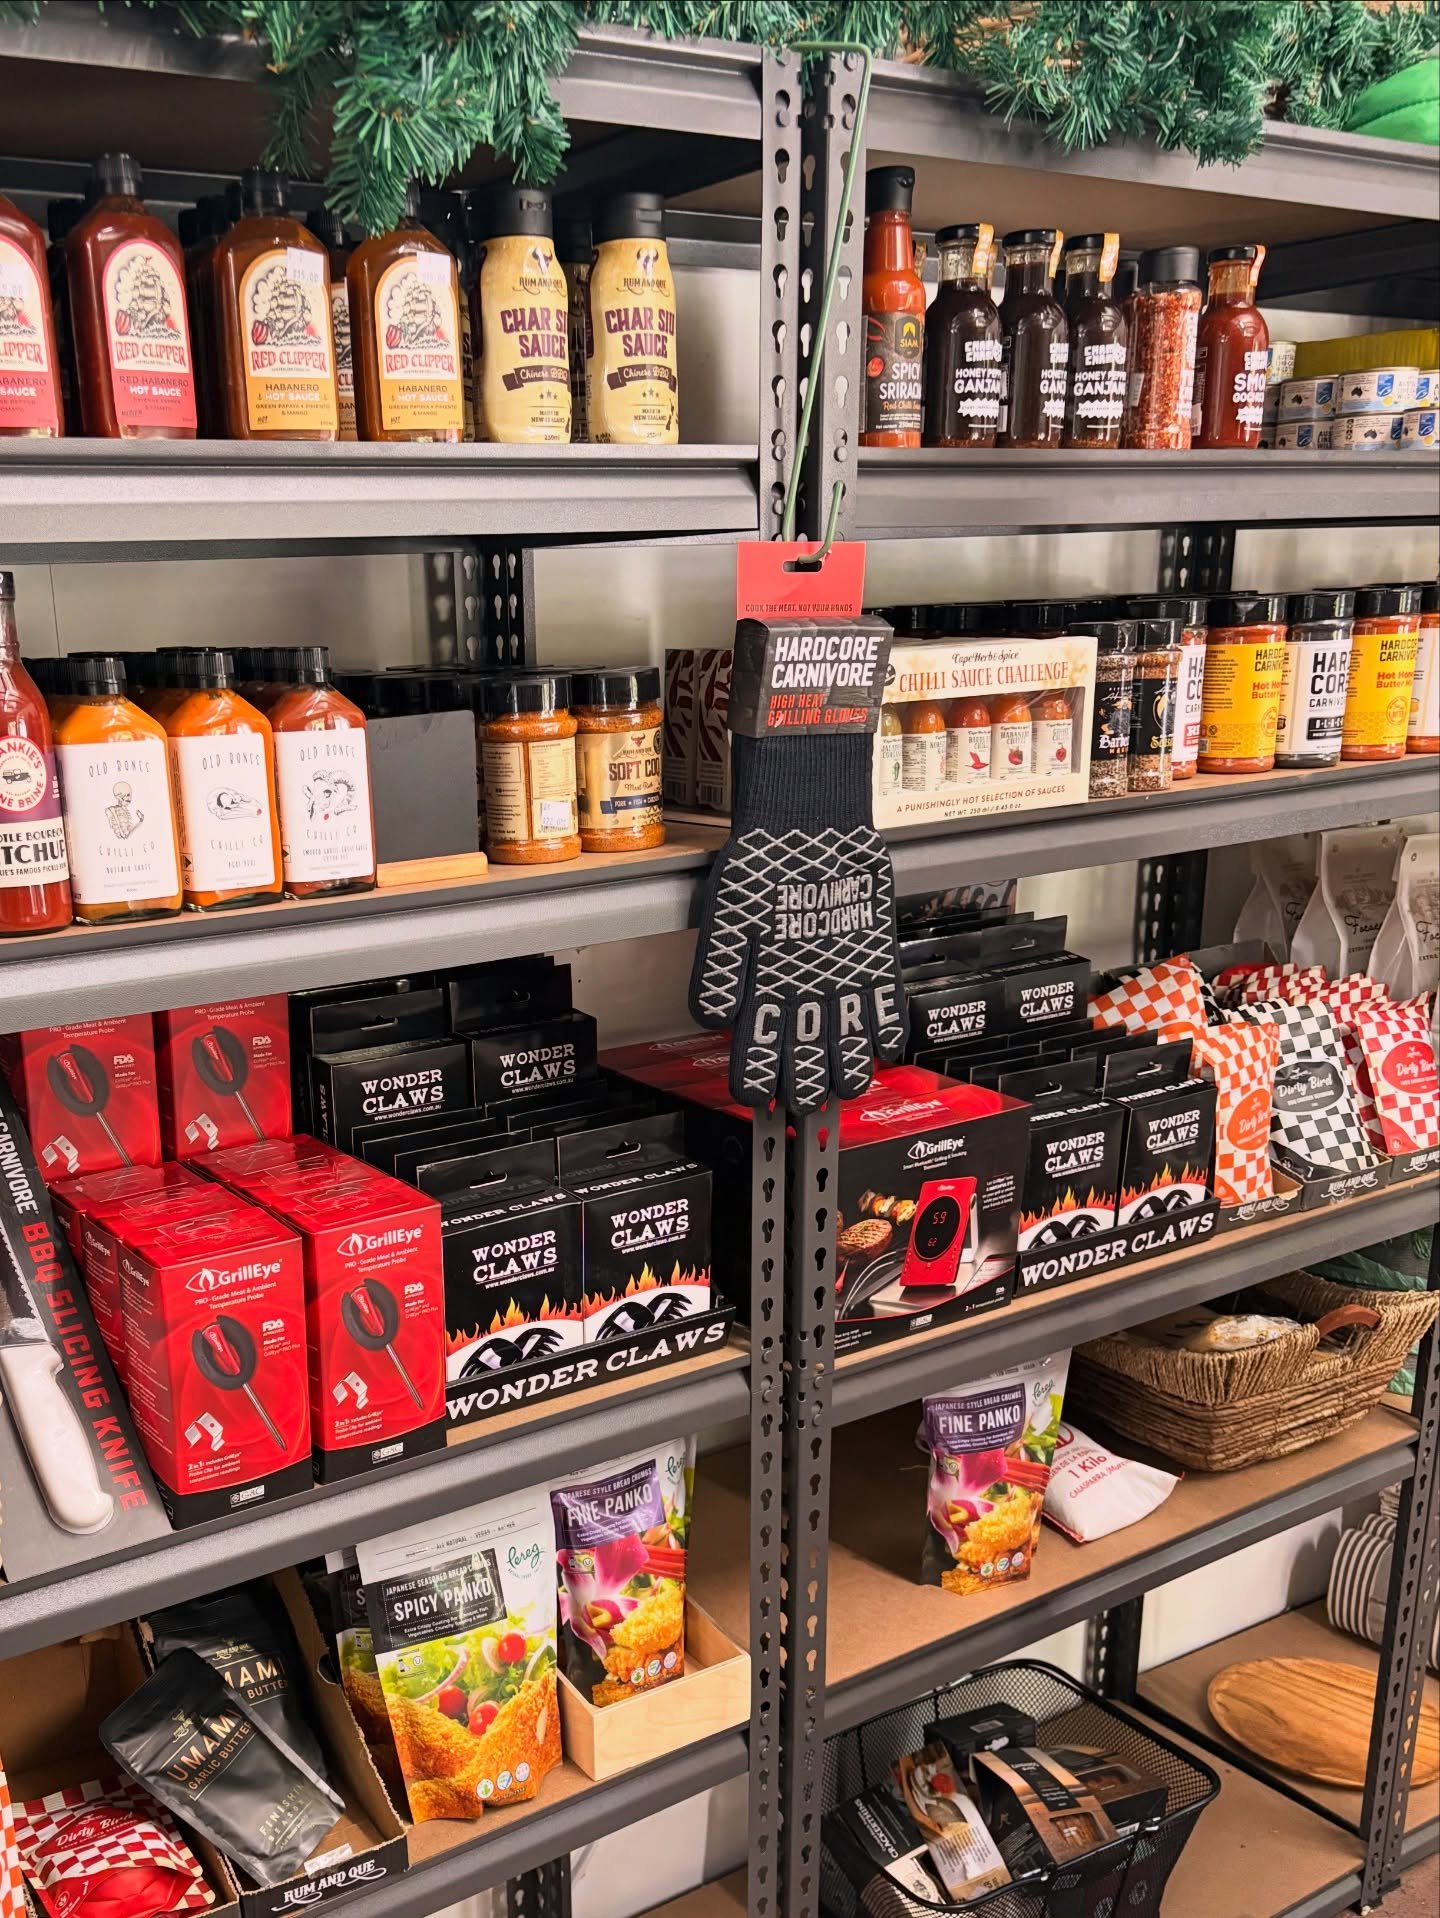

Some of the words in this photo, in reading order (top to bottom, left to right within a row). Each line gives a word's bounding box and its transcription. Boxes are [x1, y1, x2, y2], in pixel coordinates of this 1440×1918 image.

[500, 306, 551, 335] CHAR
[604, 306, 654, 335] CHAR
[657, 309, 676, 337] SIU
[115, 341, 138, 361] RED
[518, 333, 567, 360] SAUCE
[621, 333, 669, 359] SAUCE
[250, 350, 277, 372] RED
[279, 350, 327, 371] CLIPPER
[385, 353, 409, 374] RED
[411, 353, 456, 375] CLIPPER
[519, 367, 549, 380] Chinese
[623, 367, 652, 380] Chinese
[129, 385, 150, 396] HOT
[152, 386, 182, 397] SAUCE
[141, 376, 190, 388] HABANERO
[265, 383, 320, 392] HABANERO
[398, 385, 449, 393] HABANERO
[265, 392, 286, 401] HOT
[745, 603, 765, 613] COOK
[765, 603, 777, 613] THE
[798, 603, 811, 613] NOT
[811, 603, 830, 613] YOUR
[774, 636, 881, 662] HARDCORE
[770, 662, 877, 689] CARNIVORE
[899, 670, 947, 693] CHILLI
[951, 667, 993, 689] SAUCE
[996, 660, 1070, 685] CHALLENGE
[1252, 681, 1270, 691] Hot
[1376, 670, 1396, 681] Hot
[769, 694, 798, 710] HIGH
[797, 693, 826, 709] HEAT
[824, 707, 869, 724] GLOVES
[608, 760, 642, 781] SOFT
[904, 797, 961, 813] PUNISHINGLY
[962, 795, 980, 805] HOT
[980, 790, 1024, 804] SELECTION
[1024, 788, 1036, 798] OF
[1036, 784, 1066, 797] SAUCES
[774, 873, 874, 913] CARNIVORE
[773, 900, 874, 941] HARDCORE
[1020, 979, 1075, 1002] WONDER
[206, 1011, 241, 1022] Temperature
[240, 1009, 256, 1018] Probe
[208, 1005, 224, 1015] Grade
[223, 1003, 239, 1013] Meat
[244, 1000, 266, 1011] Ambient
[927, 999, 987, 1023] WONDER
[1018, 994, 1075, 1018] CLAWS
[62, 1029, 99, 1040] Temperature
[98, 1026, 116, 1037] Probe
[64, 1023, 82, 1033] Grade
[81, 1021, 97, 1030] Meat
[102, 1016, 128, 1028] Ambient
[926, 1013, 987, 1038] CLAWS
[252, 1034, 273, 1047] FDA
[113, 1053, 136, 1065] FDA
[500, 1042, 576, 1069] WONDER
[361, 1067, 444, 1096] WONDER
[500, 1059, 577, 1088] CLAWS
[1395, 1062, 1419, 1078] Dirty
[1116, 1086, 1166, 1104] WONDER
[1165, 1077, 1206, 1094] CLAWS
[1276, 1080, 1308, 1099] Dirty
[1308, 1073, 1334, 1088] Bird
[362, 1084, 445, 1116] CLAWS
[1069, 1101, 1110, 1116] CLAWS
[1147, 1108, 1201, 1133] WONDER
[926, 1137, 965, 1155] GrillEye
[1045, 1131, 1106, 1157] WONDER
[1146, 1122, 1200, 1150] CLAWS
[0, 1122, 37, 1215] CARNIVORE
[1044, 1145, 1105, 1174] CLAWS
[573, 1175, 645, 1197] WONDER
[646, 1162, 699, 1180] CLAWS
[508, 1192, 567, 1212] CLAWS
[610, 1198, 690, 1230] WONDER
[366, 1226, 423, 1250] GrillEye
[610, 1214, 691, 1248] CLAWS
[344, 1261, 357, 1269] PRO
[359, 1257, 377, 1266] Grade
[376, 1253, 390, 1262] Meat
[395, 1246, 418, 1256] Ambient
[471, 1229, 557, 1264] WONDER
[1021, 1237, 1128, 1288] WONDER
[1130, 1211, 1215, 1254] CLAWS
[219, 1261, 282, 1286] GrillEye
[357, 1260, 391, 1273] Temperature
[391, 1256, 408, 1266] Probe
[472, 1246, 559, 1283] CLAWS
[404, 1281, 425, 1295] FDA
[484, 1266, 555, 1290] www.wonderclaws.com.au
[194, 1296, 209, 1306] PRO
[211, 1292, 230, 1303] Grade
[230, 1289, 246, 1298] Meat
[251, 1281, 277, 1293] Ambient
[208, 1297, 247, 1310] Temperature
[246, 1292, 265, 1302] Probe
[262, 1318, 285, 1333] FDA
[21, 1221, 64, 1283] BBQ
[45, 1293, 102, 1409] SLICING
[91, 1415, 149, 1513] KNIFE
[445, 1357, 599, 1421] WONDER
[605, 1321, 727, 1373] CLAWS
[935, 1400, 966, 1411] JAPANESE
[965, 1399, 984, 1410] STYLE
[983, 1395, 1001, 1406] BREAD
[1000, 1389, 1023, 1403] CRUMBS
[938, 1414, 974, 1435] FINE
[978, 1403, 1021, 1432] PANKO
[1077, 1455, 1108, 1473] Kilo
[591, 1484, 613, 1495] STYLE
[612, 1477, 632, 1490] BREAD
[630, 1466, 653, 1484] CRUMBS
[1069, 1471, 1108, 1499] CALASPARRA
[604, 1482, 654, 1516] PANKO
[445, 1535, 469, 1548] NATURAL
[385, 1582, 418, 1597] JAPANESE
[416, 1572, 449, 1589] SEASONED
[447, 1566, 469, 1580] BREAD
[393, 1592, 440, 1622] SPICY
[443, 1576, 492, 1610] PANKO
[416, 1622, 433, 1632] Crispy
[431, 1619, 451, 1629] Coating
[433, 1622, 455, 1633] Crunchy
[166, 1707, 243, 1783] UMAMI
[188, 1759, 222, 1792] GARLIC
[218, 1720, 254, 1765] BUTTER
[55, 1823, 95, 1847] Dirty
[99, 1810, 134, 1829] Bird
[283, 1880, 316, 1904] RUM
[315, 1870, 347, 1892] AND
[346, 1858, 377, 1881] QUE
